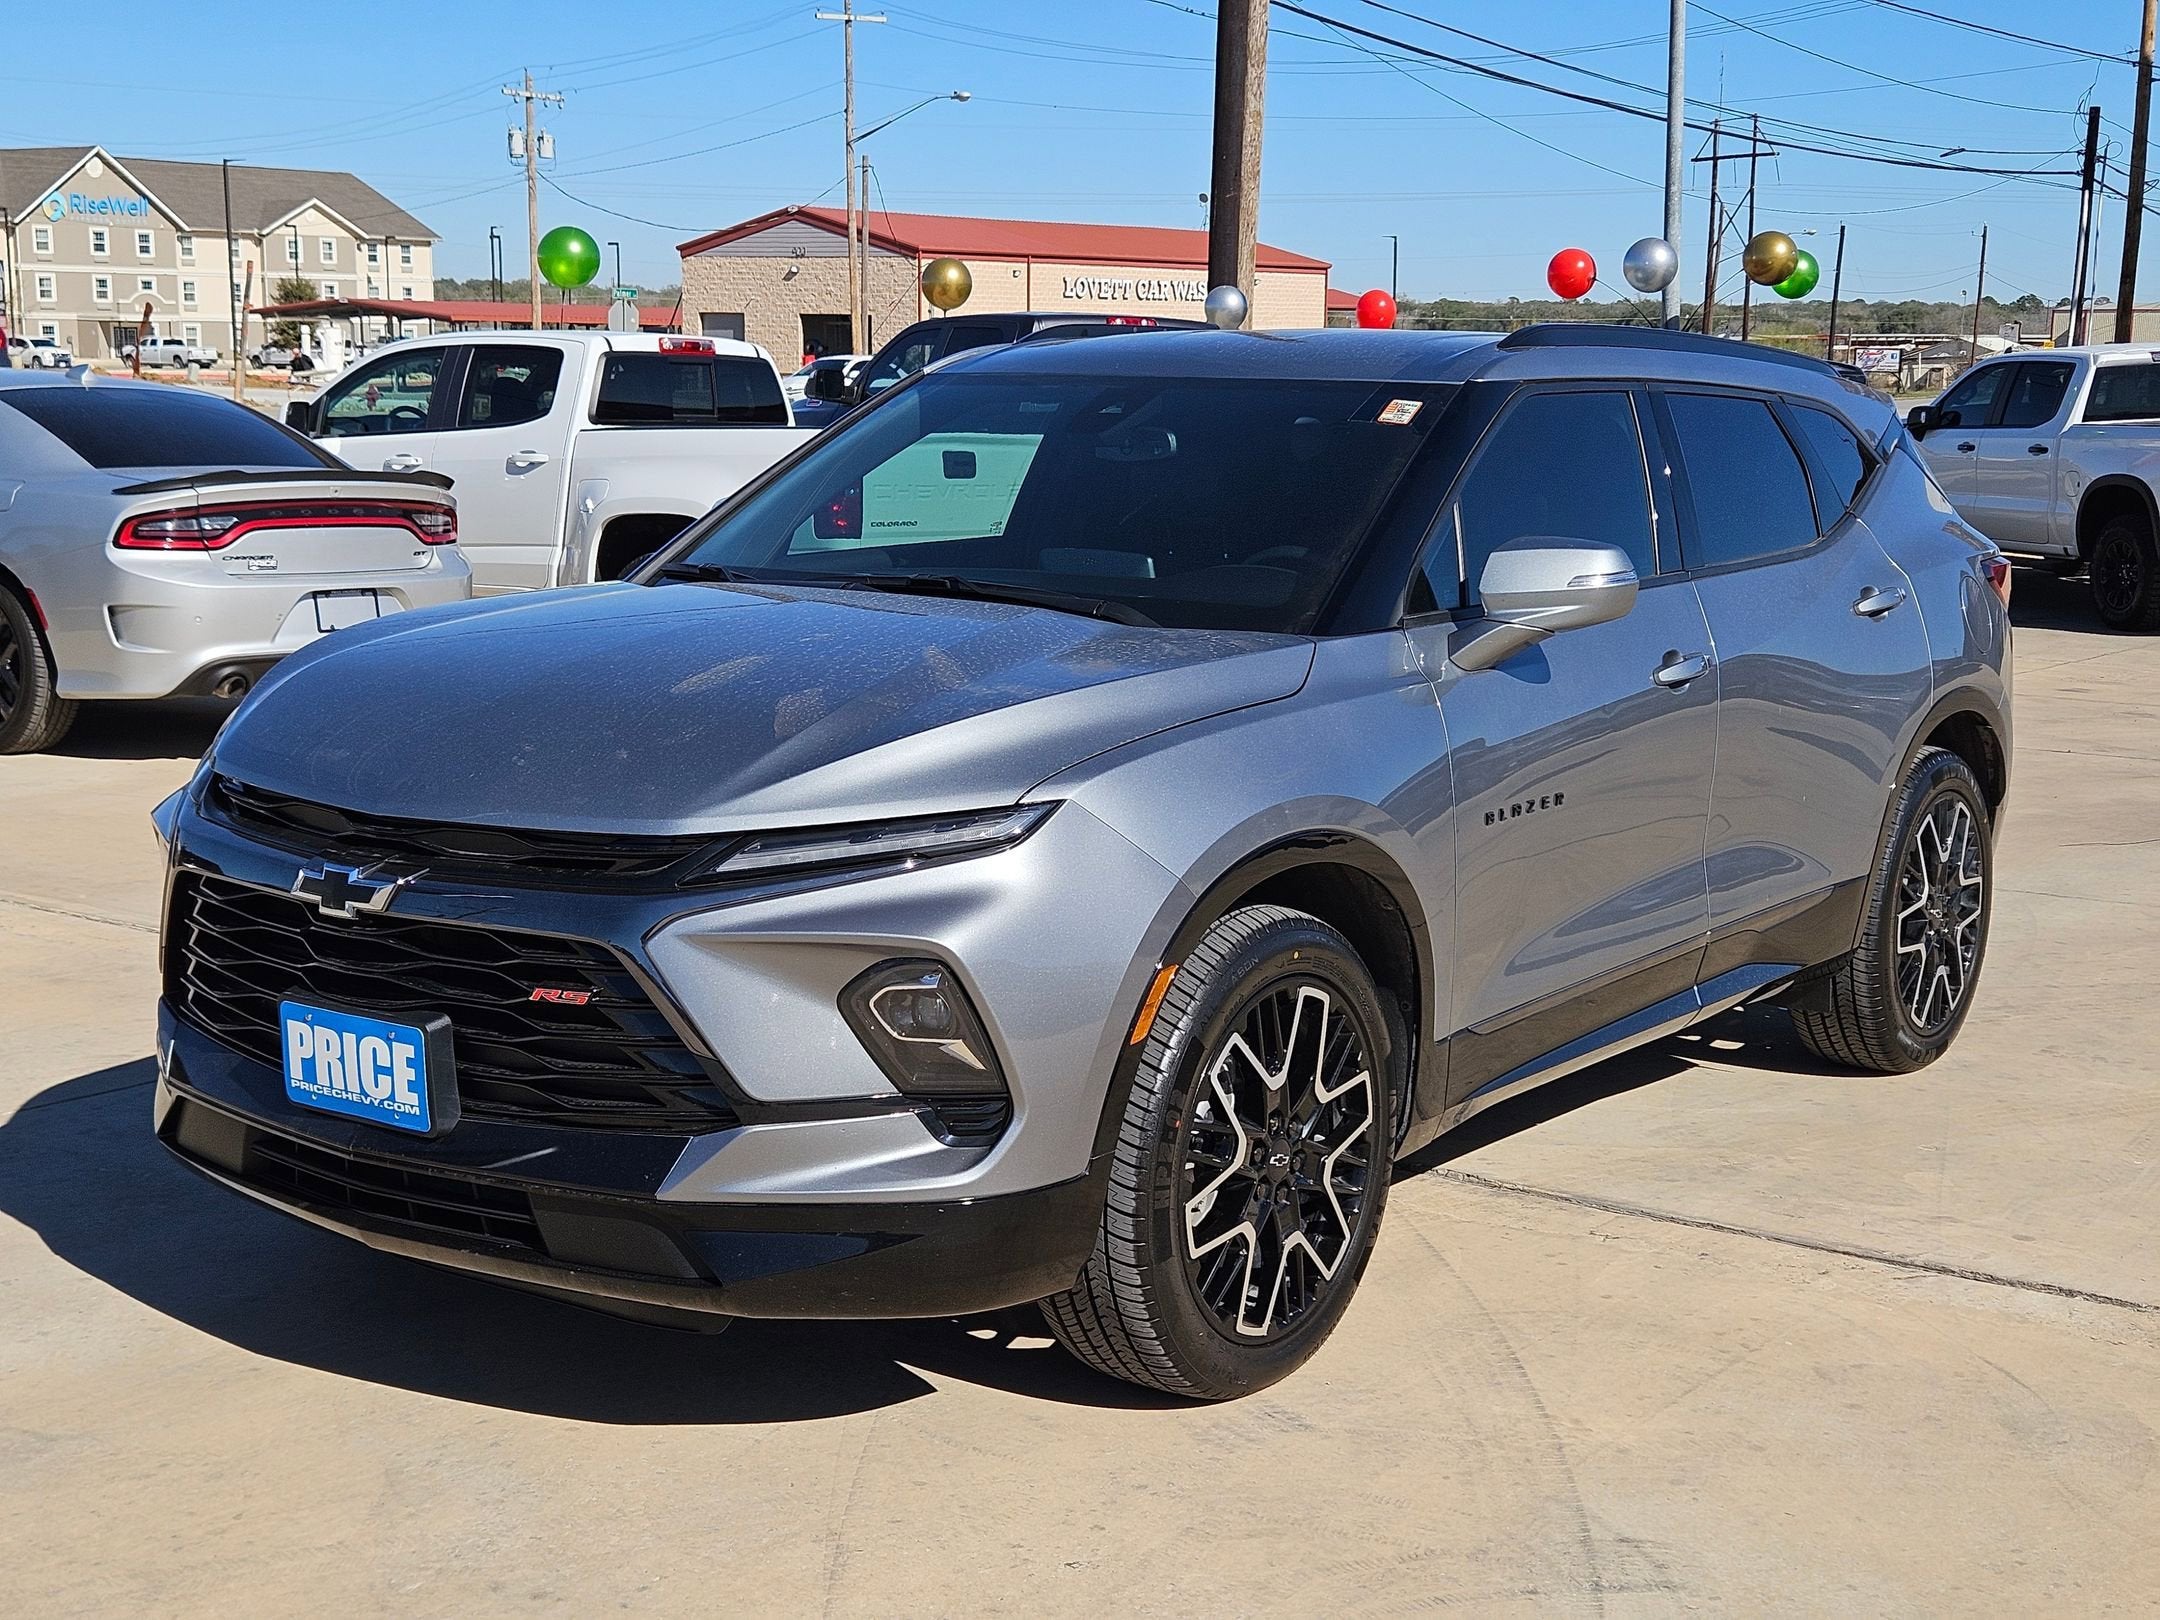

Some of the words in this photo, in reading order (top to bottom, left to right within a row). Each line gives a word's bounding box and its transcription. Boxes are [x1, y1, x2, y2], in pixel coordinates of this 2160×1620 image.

[70, 191, 149, 217] RiseWell
[1063, 276, 1133, 300] LOVETT
[1135, 279, 1168, 301] CAR
[1170, 280, 1209, 302] WAS
[1484, 792, 1565, 826] BLAZER
[528, 987, 592, 1005] RS
[286, 1018, 419, 1106] PRICE
[290, 1078, 420, 1116] PRICECHEVY.COM
